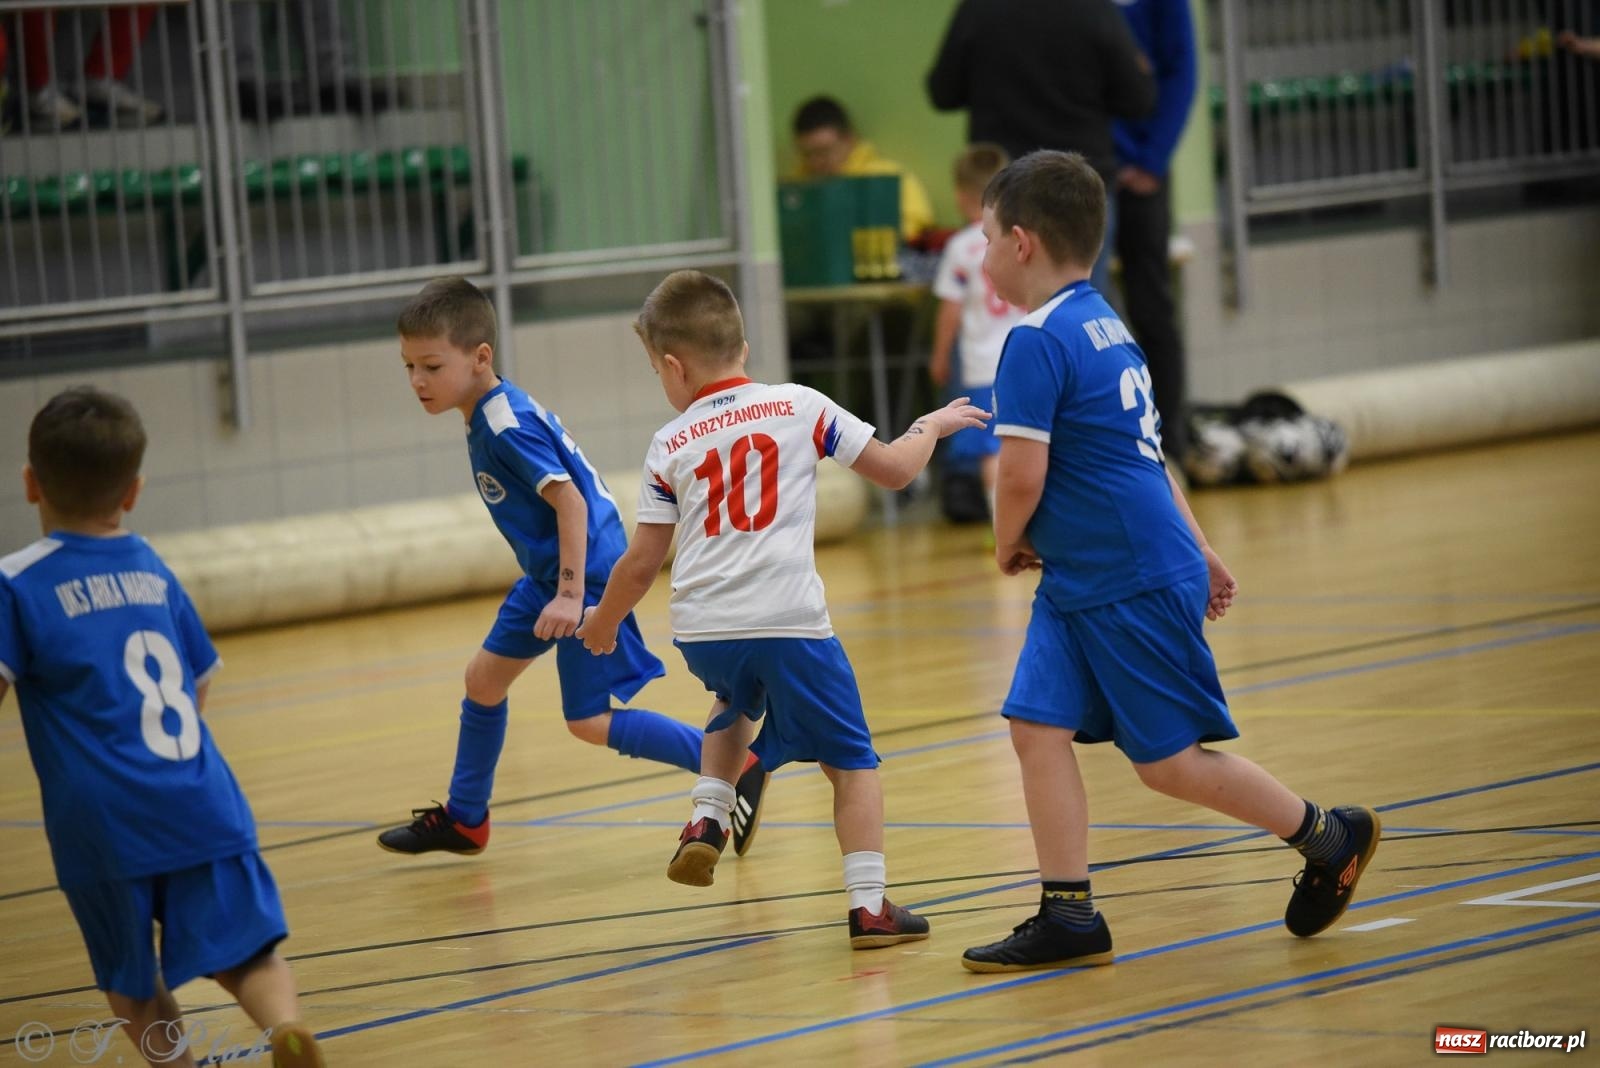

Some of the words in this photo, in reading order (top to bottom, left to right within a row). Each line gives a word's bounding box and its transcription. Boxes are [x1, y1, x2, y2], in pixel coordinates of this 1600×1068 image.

[665, 430, 688, 455] LKS
[689, 400, 795, 440] KRZYŻANOWICE
[712, 395, 736, 409] 1920
[694, 432, 779, 538] 10
[123, 629, 201, 762] 8
